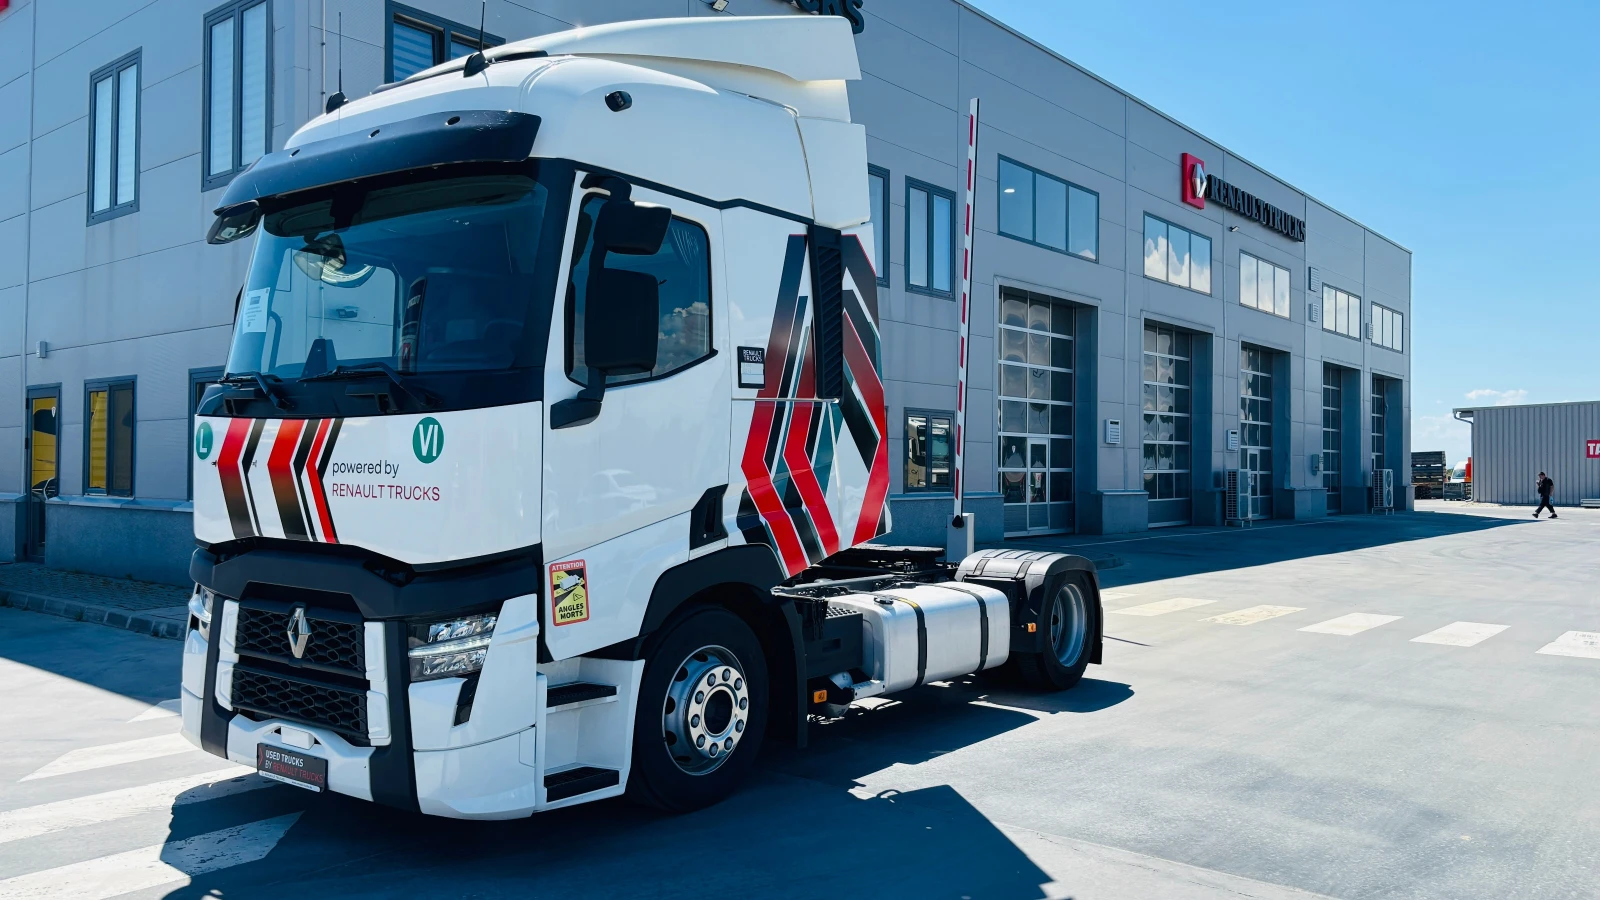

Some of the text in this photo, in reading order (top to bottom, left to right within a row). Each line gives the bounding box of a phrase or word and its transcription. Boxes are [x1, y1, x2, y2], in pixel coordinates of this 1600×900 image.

[1205, 173, 1306, 242] RENAULT TRUCKS
[199, 428, 208, 453] L
[419, 424, 439, 457] VI
[332, 460, 400, 478] powered by
[332, 483, 440, 501] RENAULT TRUCKS
[552, 561, 584, 571] ATTENTION
[558, 603, 584, 613] ANGLES
[560, 610, 584, 620] MORTS
[265, 750, 304, 767] USED TRUCKS
[265, 760, 272, 769] BY
[273, 762, 298, 776] RENAULT
[300, 769, 324, 784] TRUCKS
